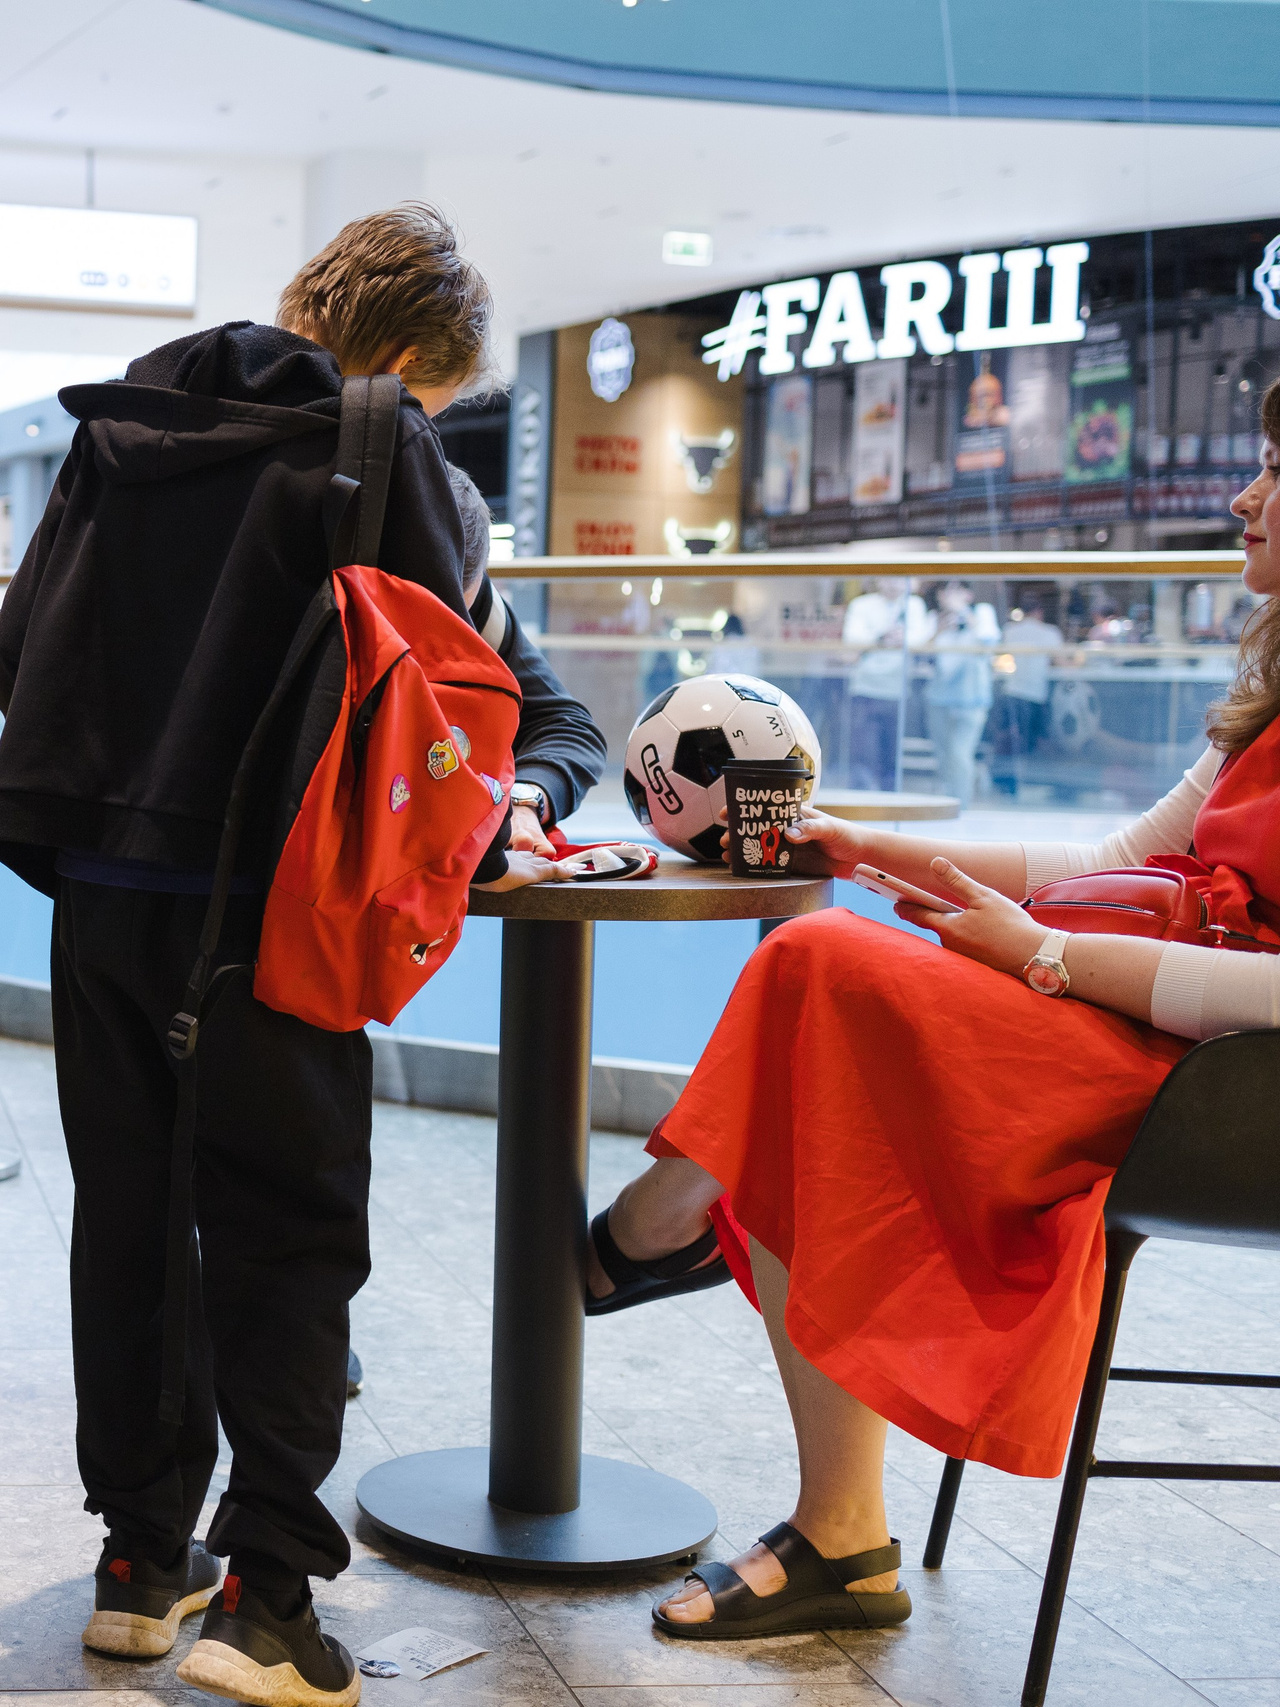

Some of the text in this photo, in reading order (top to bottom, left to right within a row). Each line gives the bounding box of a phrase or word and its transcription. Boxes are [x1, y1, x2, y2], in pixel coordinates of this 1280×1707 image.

[732, 729, 744, 739] 5
[641, 743, 684, 815] GSD
[735, 787, 801, 804] BUNGLE
[739, 804, 797, 820] IN THE
